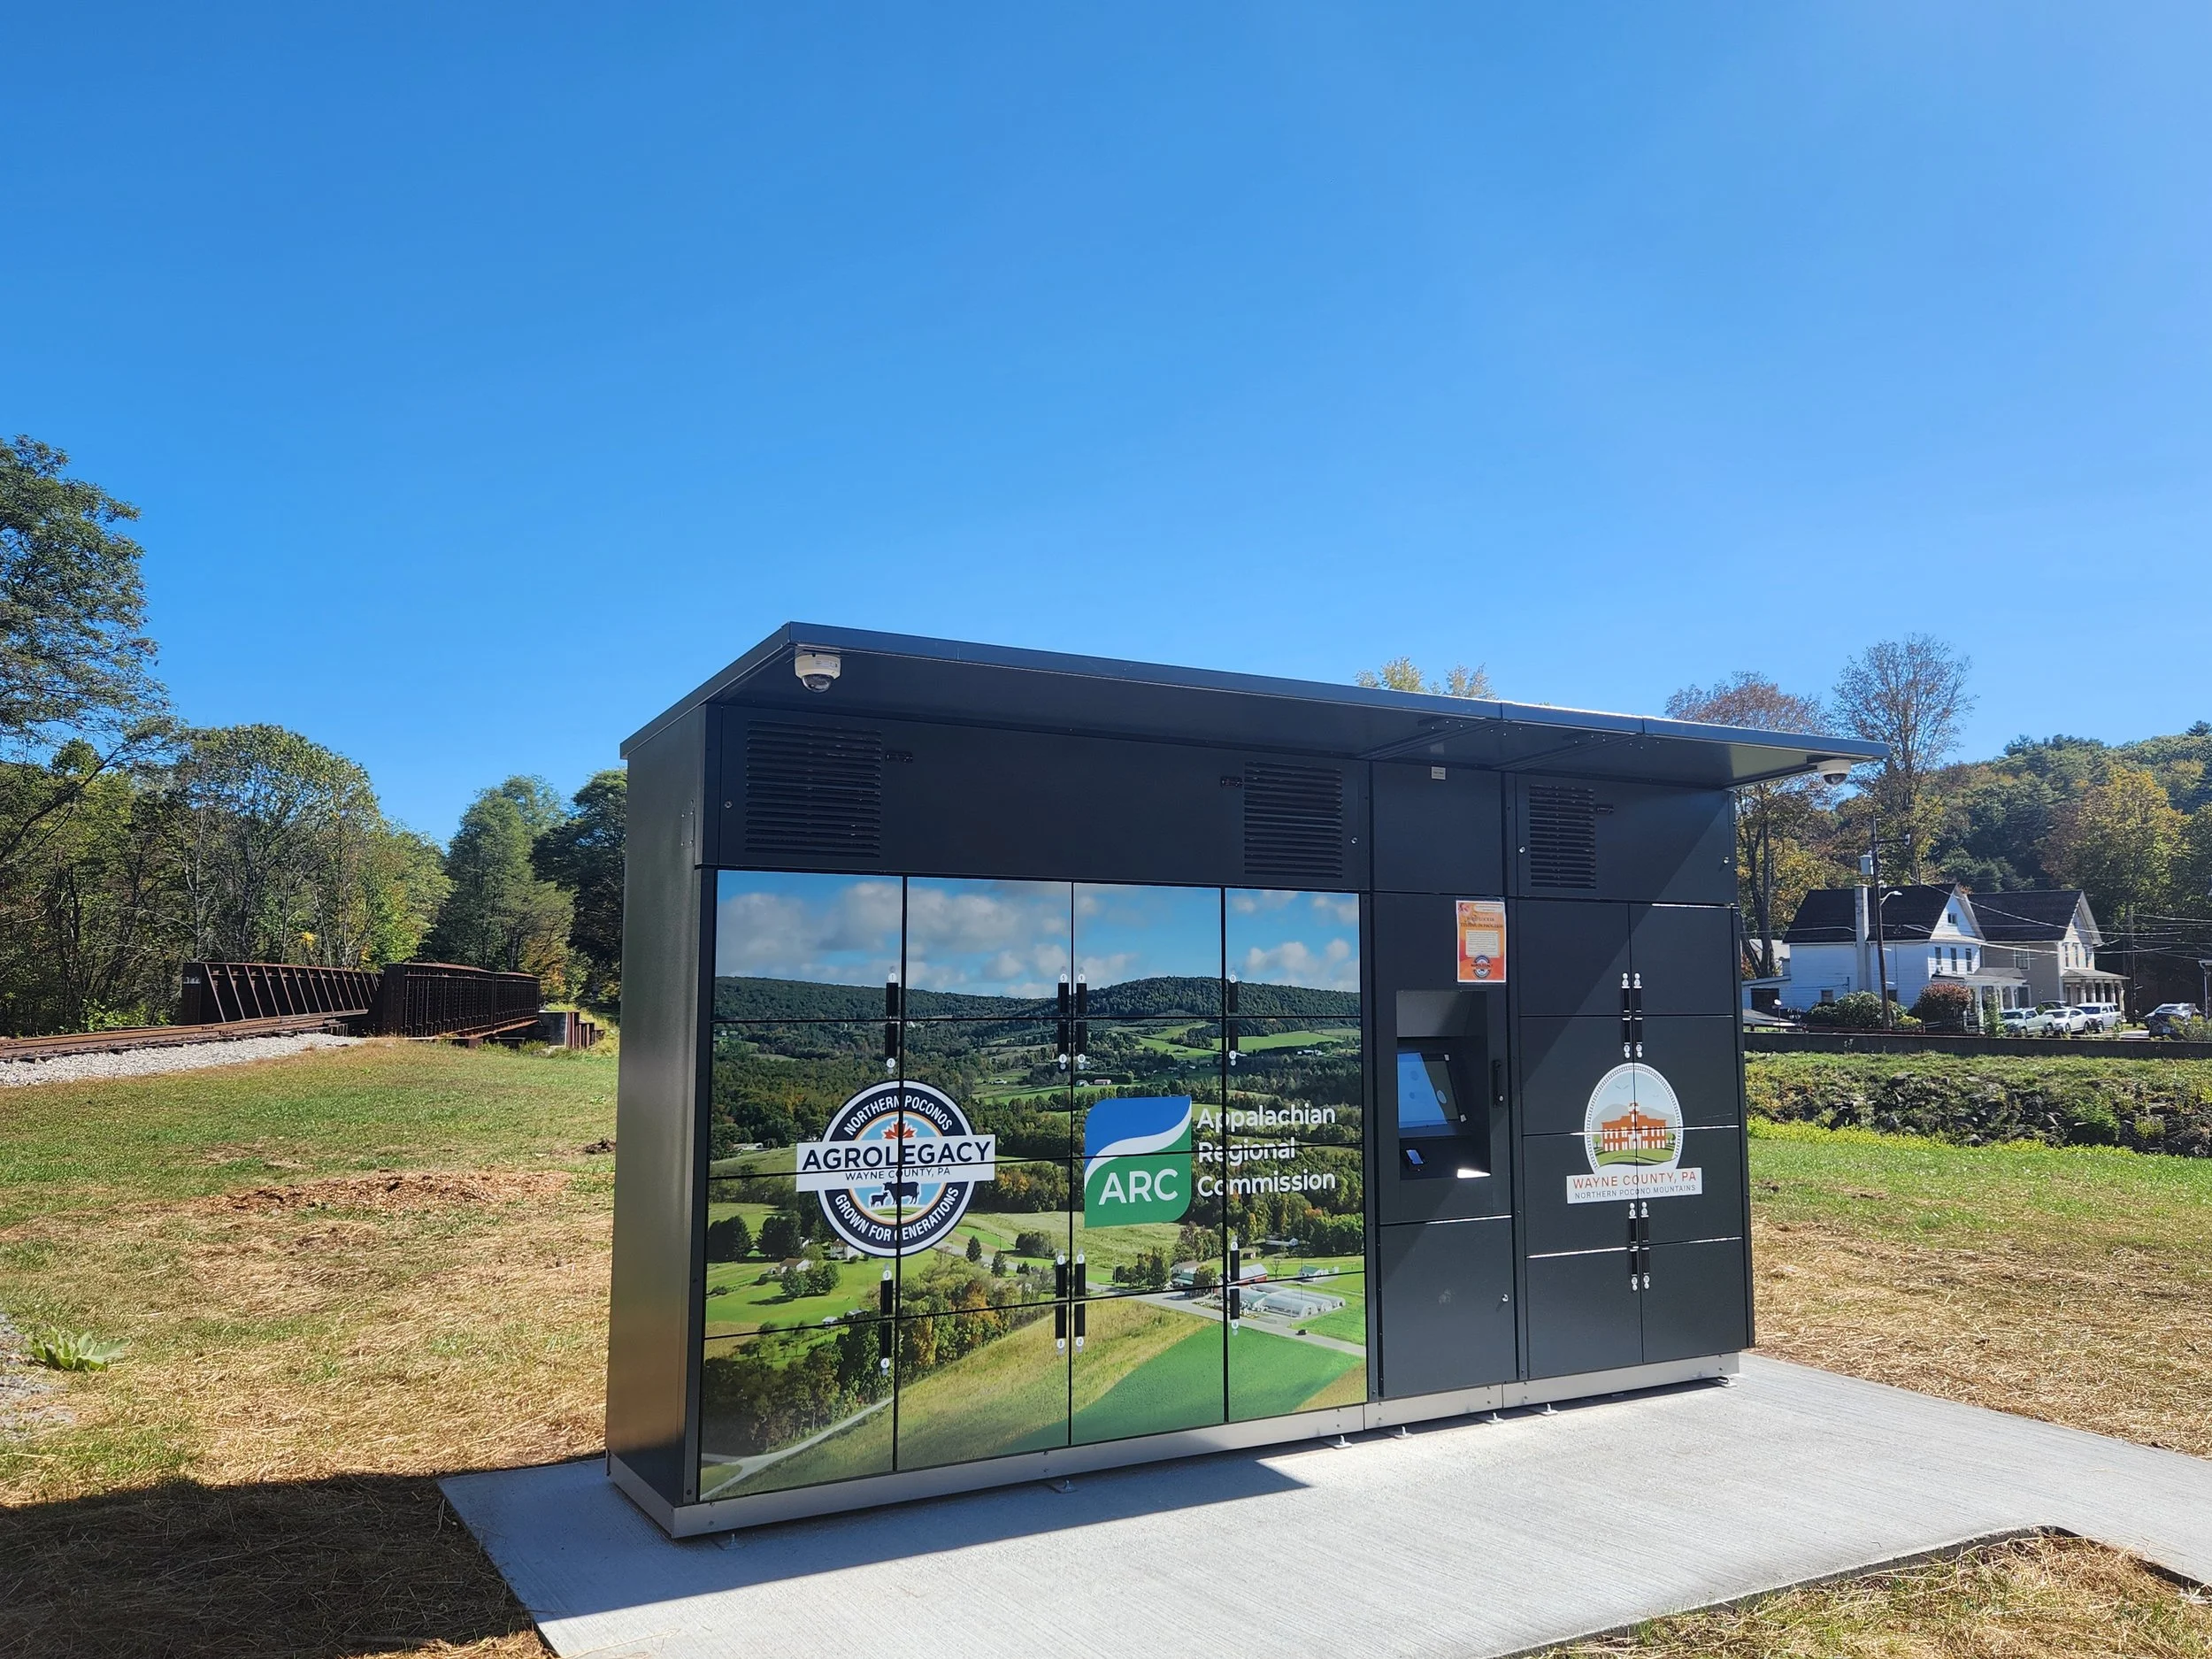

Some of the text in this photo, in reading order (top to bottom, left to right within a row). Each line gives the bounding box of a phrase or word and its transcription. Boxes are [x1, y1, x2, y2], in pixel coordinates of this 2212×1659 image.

[843, 1094, 953, 1136] NORTHERN POCONOS
[1196, 1102, 1335, 1133] Appalachian
[802, 1141, 991, 1171] AGROLEGACY
[1198, 1137, 1295, 1167] Regional
[845, 1170, 885, 1181] WAYNE
[937, 1166, 951, 1176] PA
[1098, 1168, 1179, 1206] ARC
[1197, 1169, 1335, 1197] Commission
[1573, 1171, 1697, 1189] WAYNE COUNTY, PA
[1575, 1184, 1696, 1199] NORTHERN POCONO MOUNTAINS
[835, 1194, 868, 1235] GROWN
[869, 1225, 891, 1241] FOR
